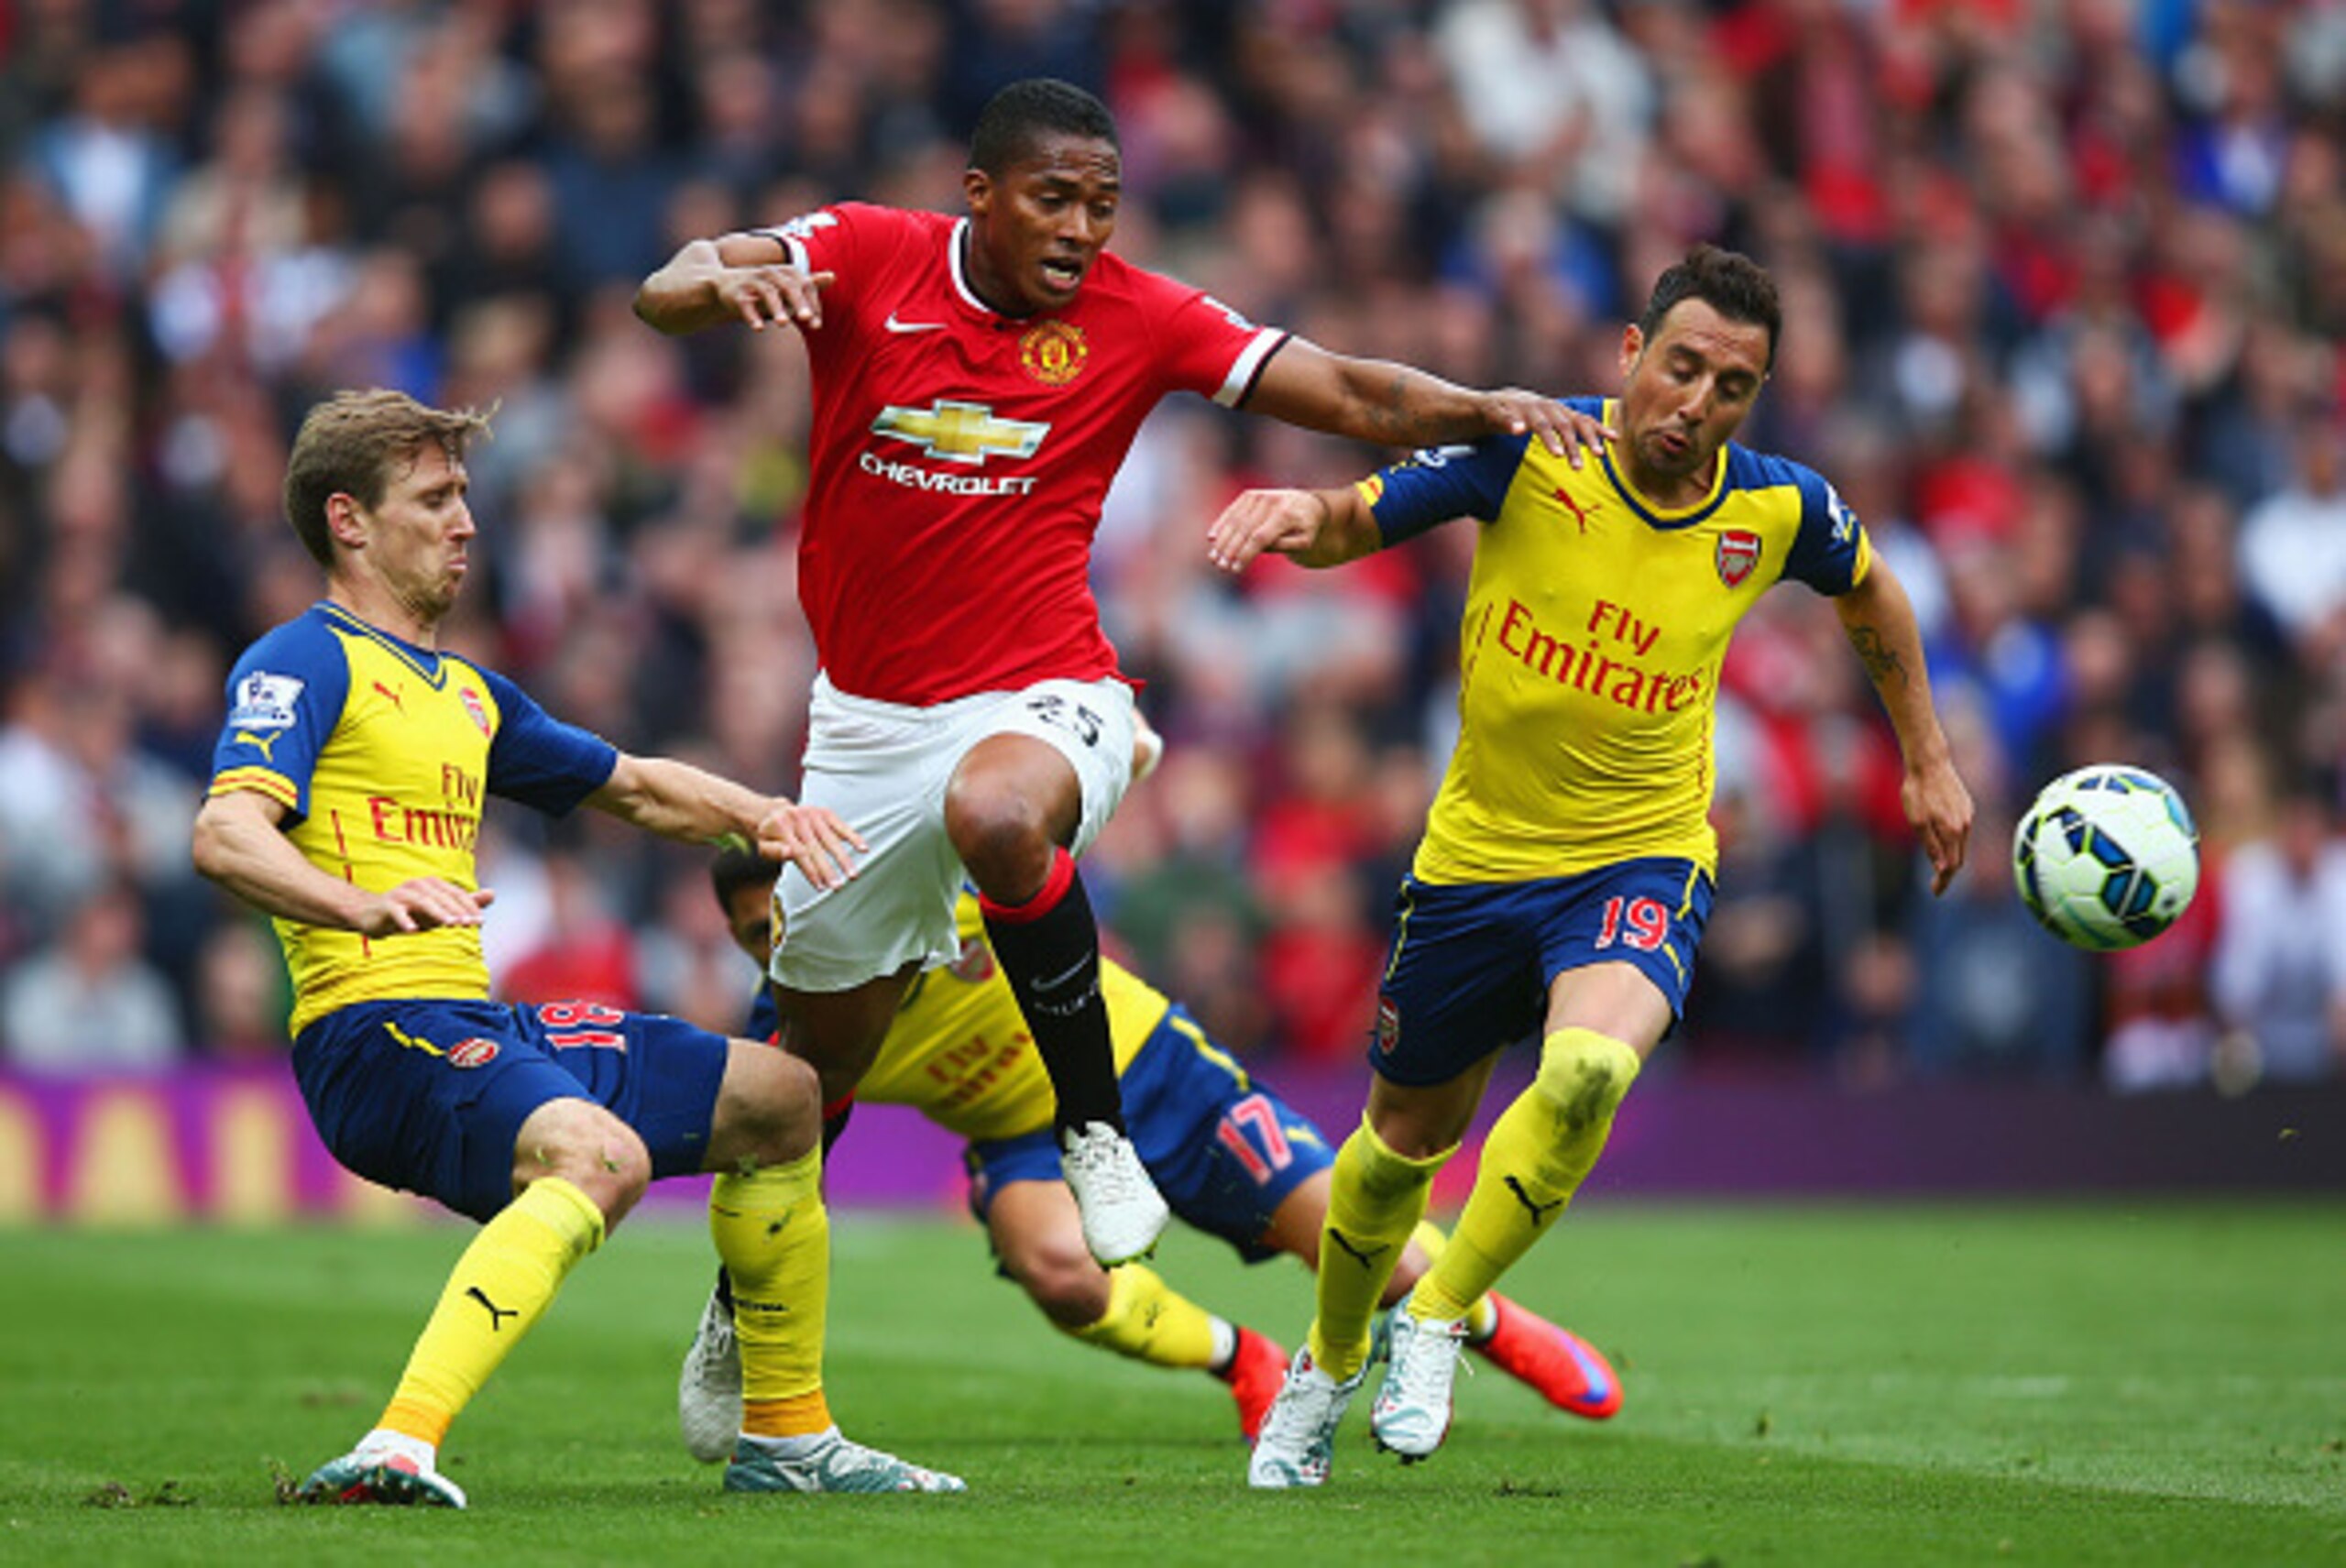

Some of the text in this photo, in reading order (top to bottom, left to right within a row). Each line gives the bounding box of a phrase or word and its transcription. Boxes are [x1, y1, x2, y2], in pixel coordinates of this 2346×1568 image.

[859, 450, 1038, 496] CHEVROLET
[1587, 599, 1661, 657] Fly
[1497, 598, 1704, 715] Emirates
[1025, 694, 1103, 749] 25
[442, 762, 478, 809] Fly
[1595, 895, 1668, 951] 19
[537, 1001, 628, 1053] 18
[1216, 1093, 1293, 1186] 17
